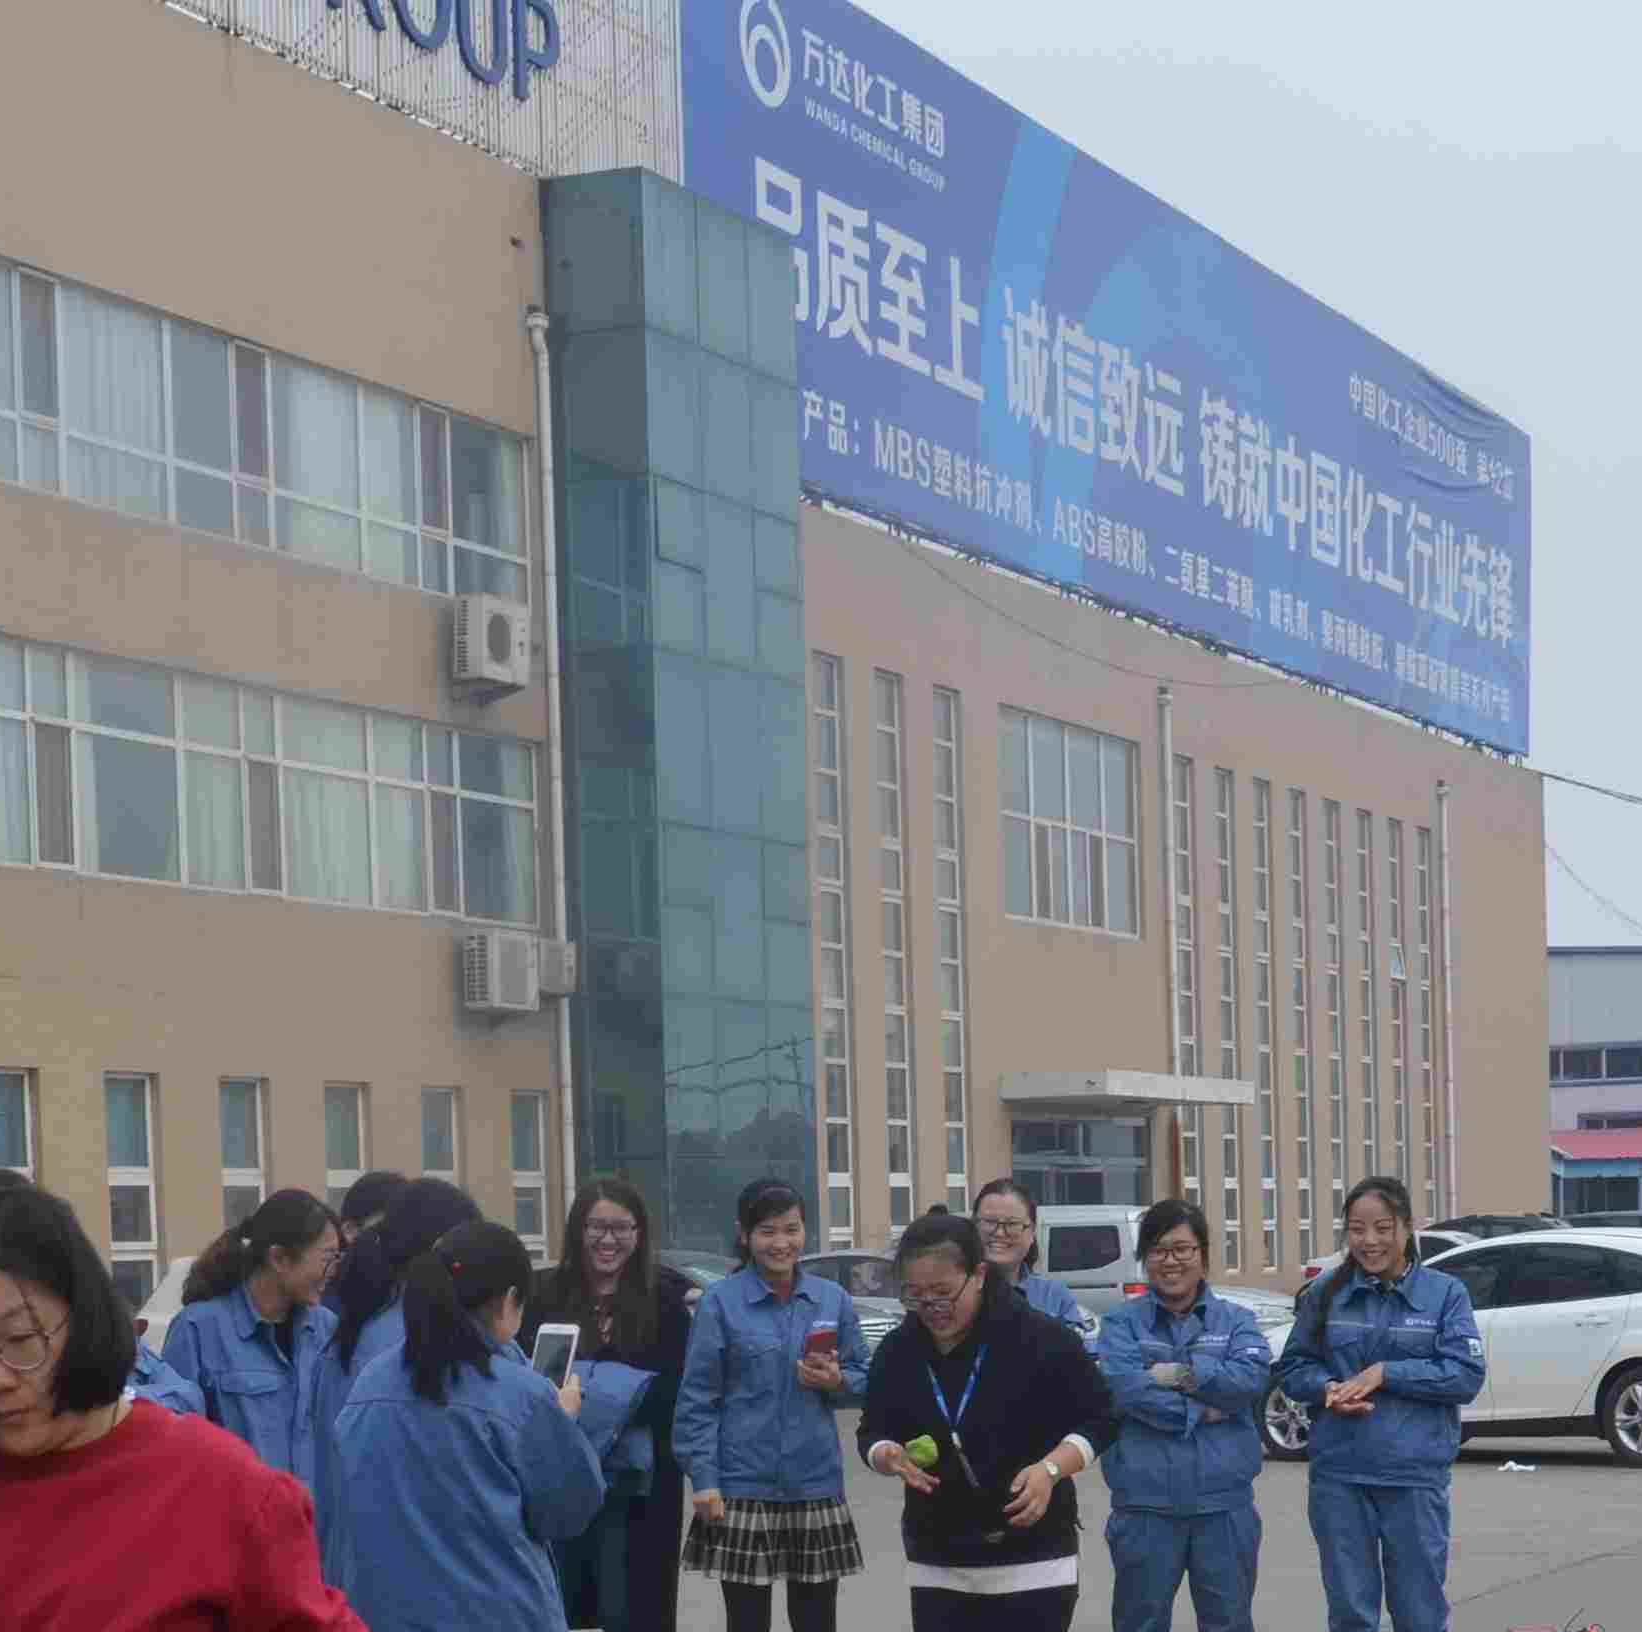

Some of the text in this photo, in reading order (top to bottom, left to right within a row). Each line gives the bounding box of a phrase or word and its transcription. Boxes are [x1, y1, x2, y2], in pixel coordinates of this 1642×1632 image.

[801, 26, 946, 159] 万达化工集团
[804, 96, 848, 139] WANDA
[851, 123, 907, 172] CHEMICAL
[755, 156, 984, 402] 品质至上
[1003, 287, 1185, 498] 诚信致远
